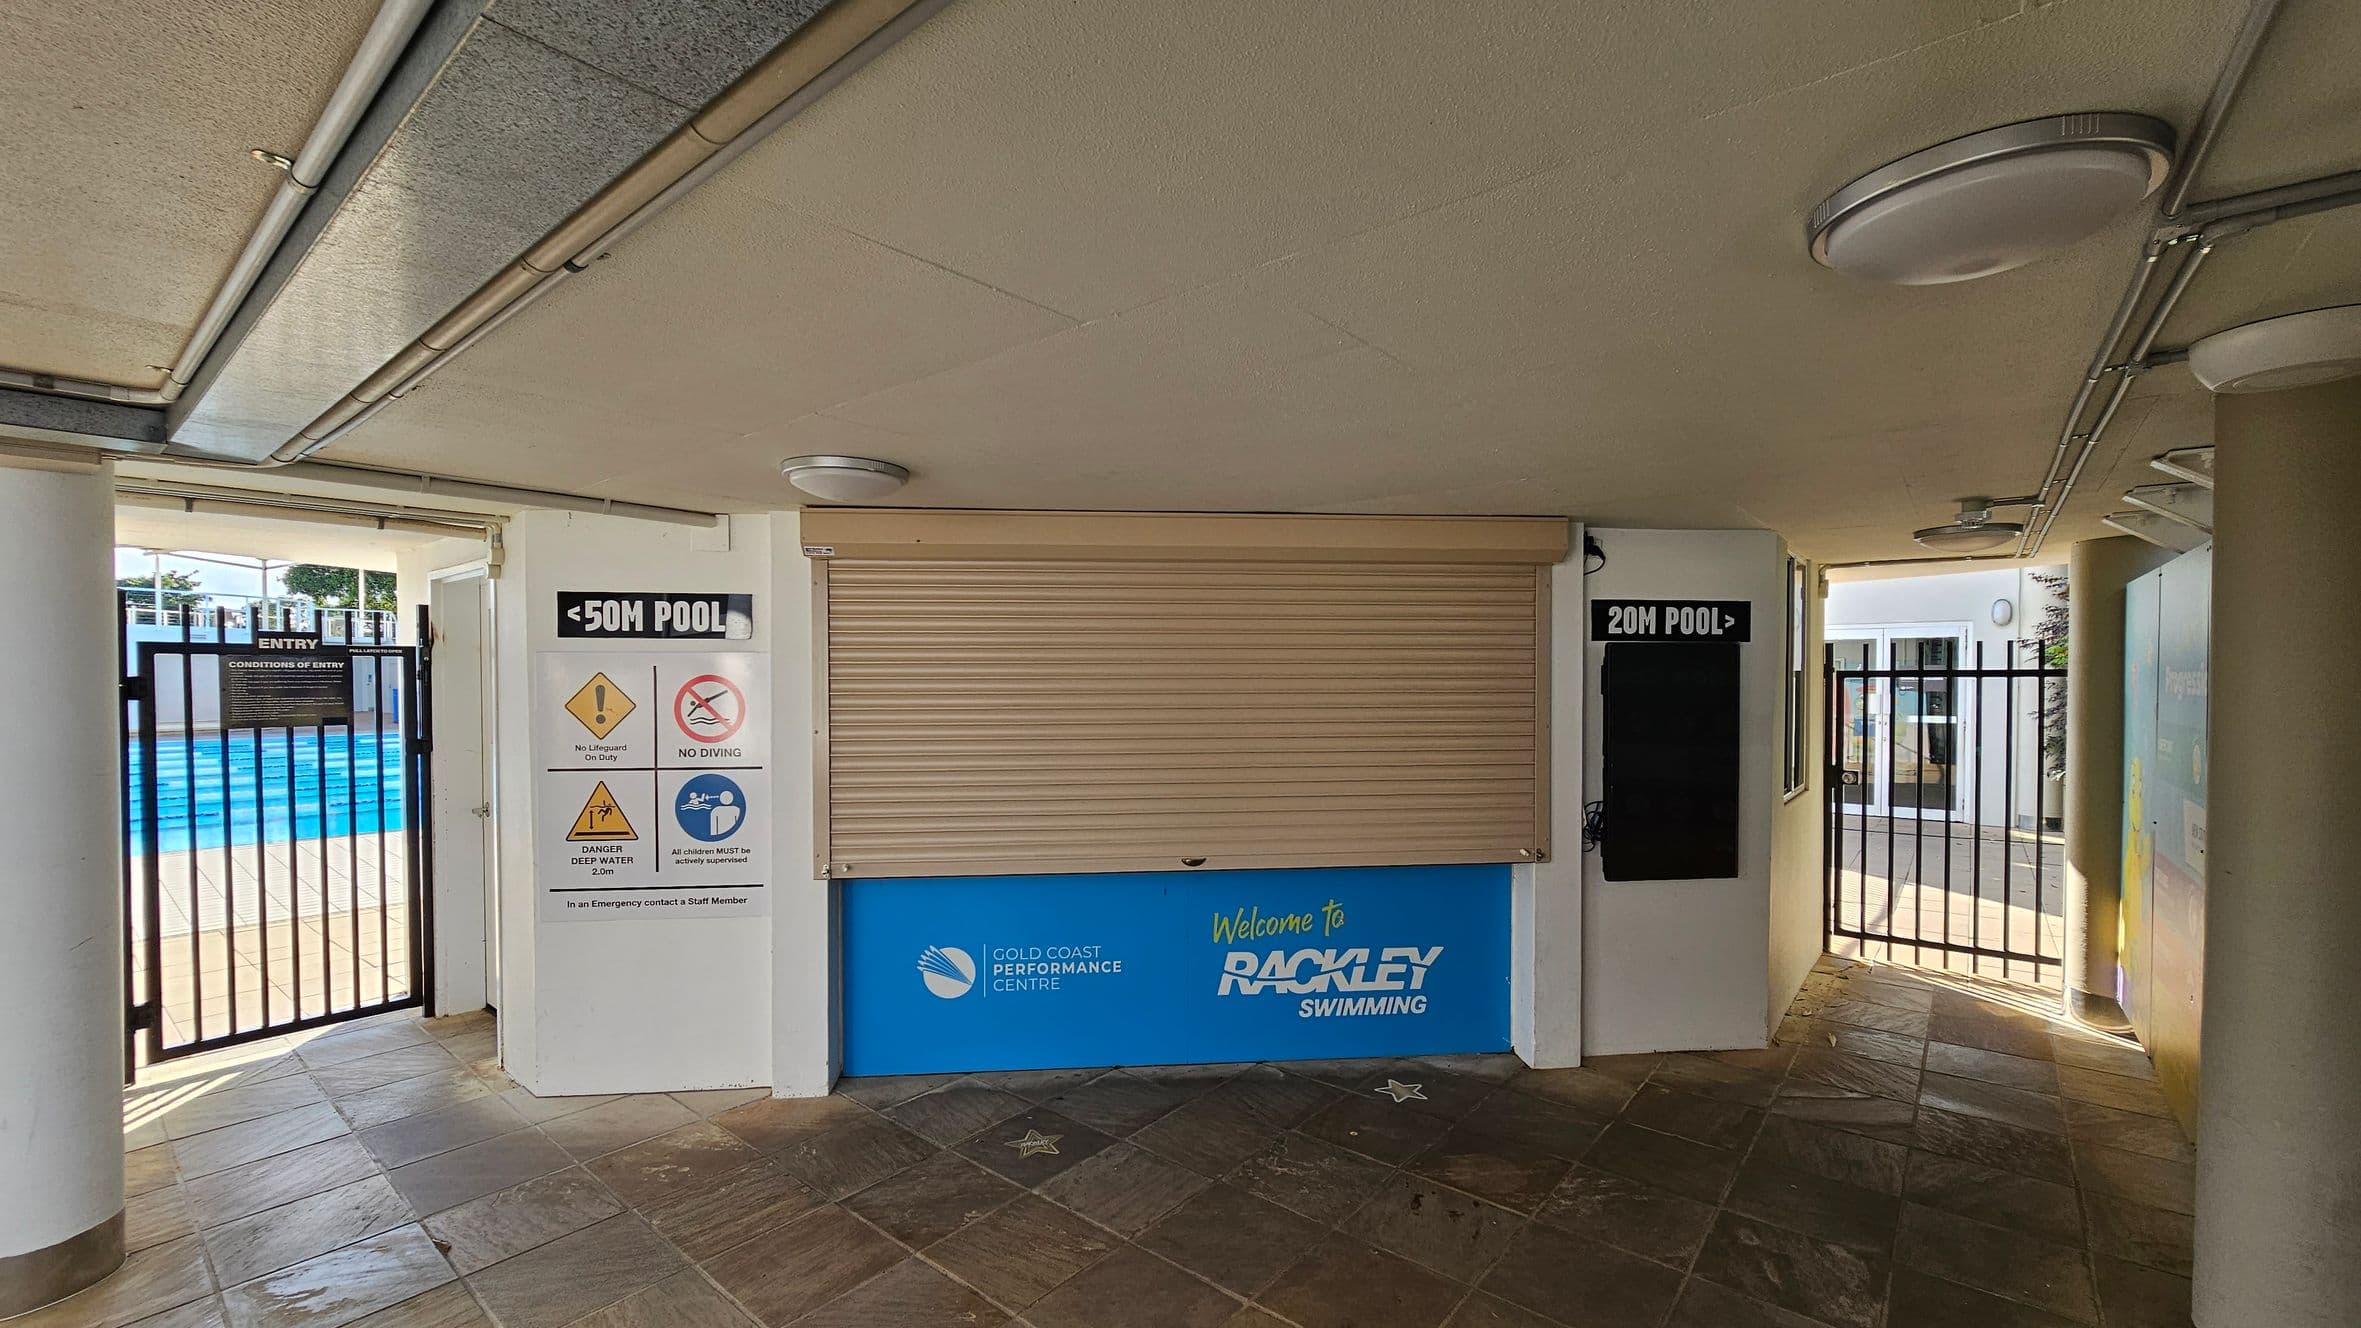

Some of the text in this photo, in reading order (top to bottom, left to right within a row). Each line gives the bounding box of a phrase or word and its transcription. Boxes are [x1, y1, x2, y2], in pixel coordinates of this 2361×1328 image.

[654, 600, 726, 632] POOL
[1608, 606, 1656, 635] 20M
[258, 638, 318, 650] ENTRY
[228, 661, 295, 669] CONDITIONS
[588, 744, 627, 753] Lifeguard
[678, 748, 742, 758] NO DIVING
[599, 754, 618, 762] Duty
[582, 845, 623, 854] DANGER
[671, 848, 682, 856] All
[716, 847, 739, 855] MUST
[571, 856, 634, 865] DEEP WATER
[675, 857, 748, 866] actively supervised
[591, 868, 614, 876] 2.0m
[567, 901, 576, 909] In
[591, 900, 642, 909] Emergency
[644, 898, 678, 907] contact
[687, 898, 709, 906] Staff
[711, 897, 748, 905] Member
[1212, 898, 1345, 944] Welcome to
[993, 945, 1102, 961] GOLD COAST
[993, 960, 1122, 976] PERFORMANCE
[1217, 946, 1444, 996] RACKLEY
[993, 977, 1060, 992] CENTRE
[1298, 995, 1427, 1018] SWIMMING
